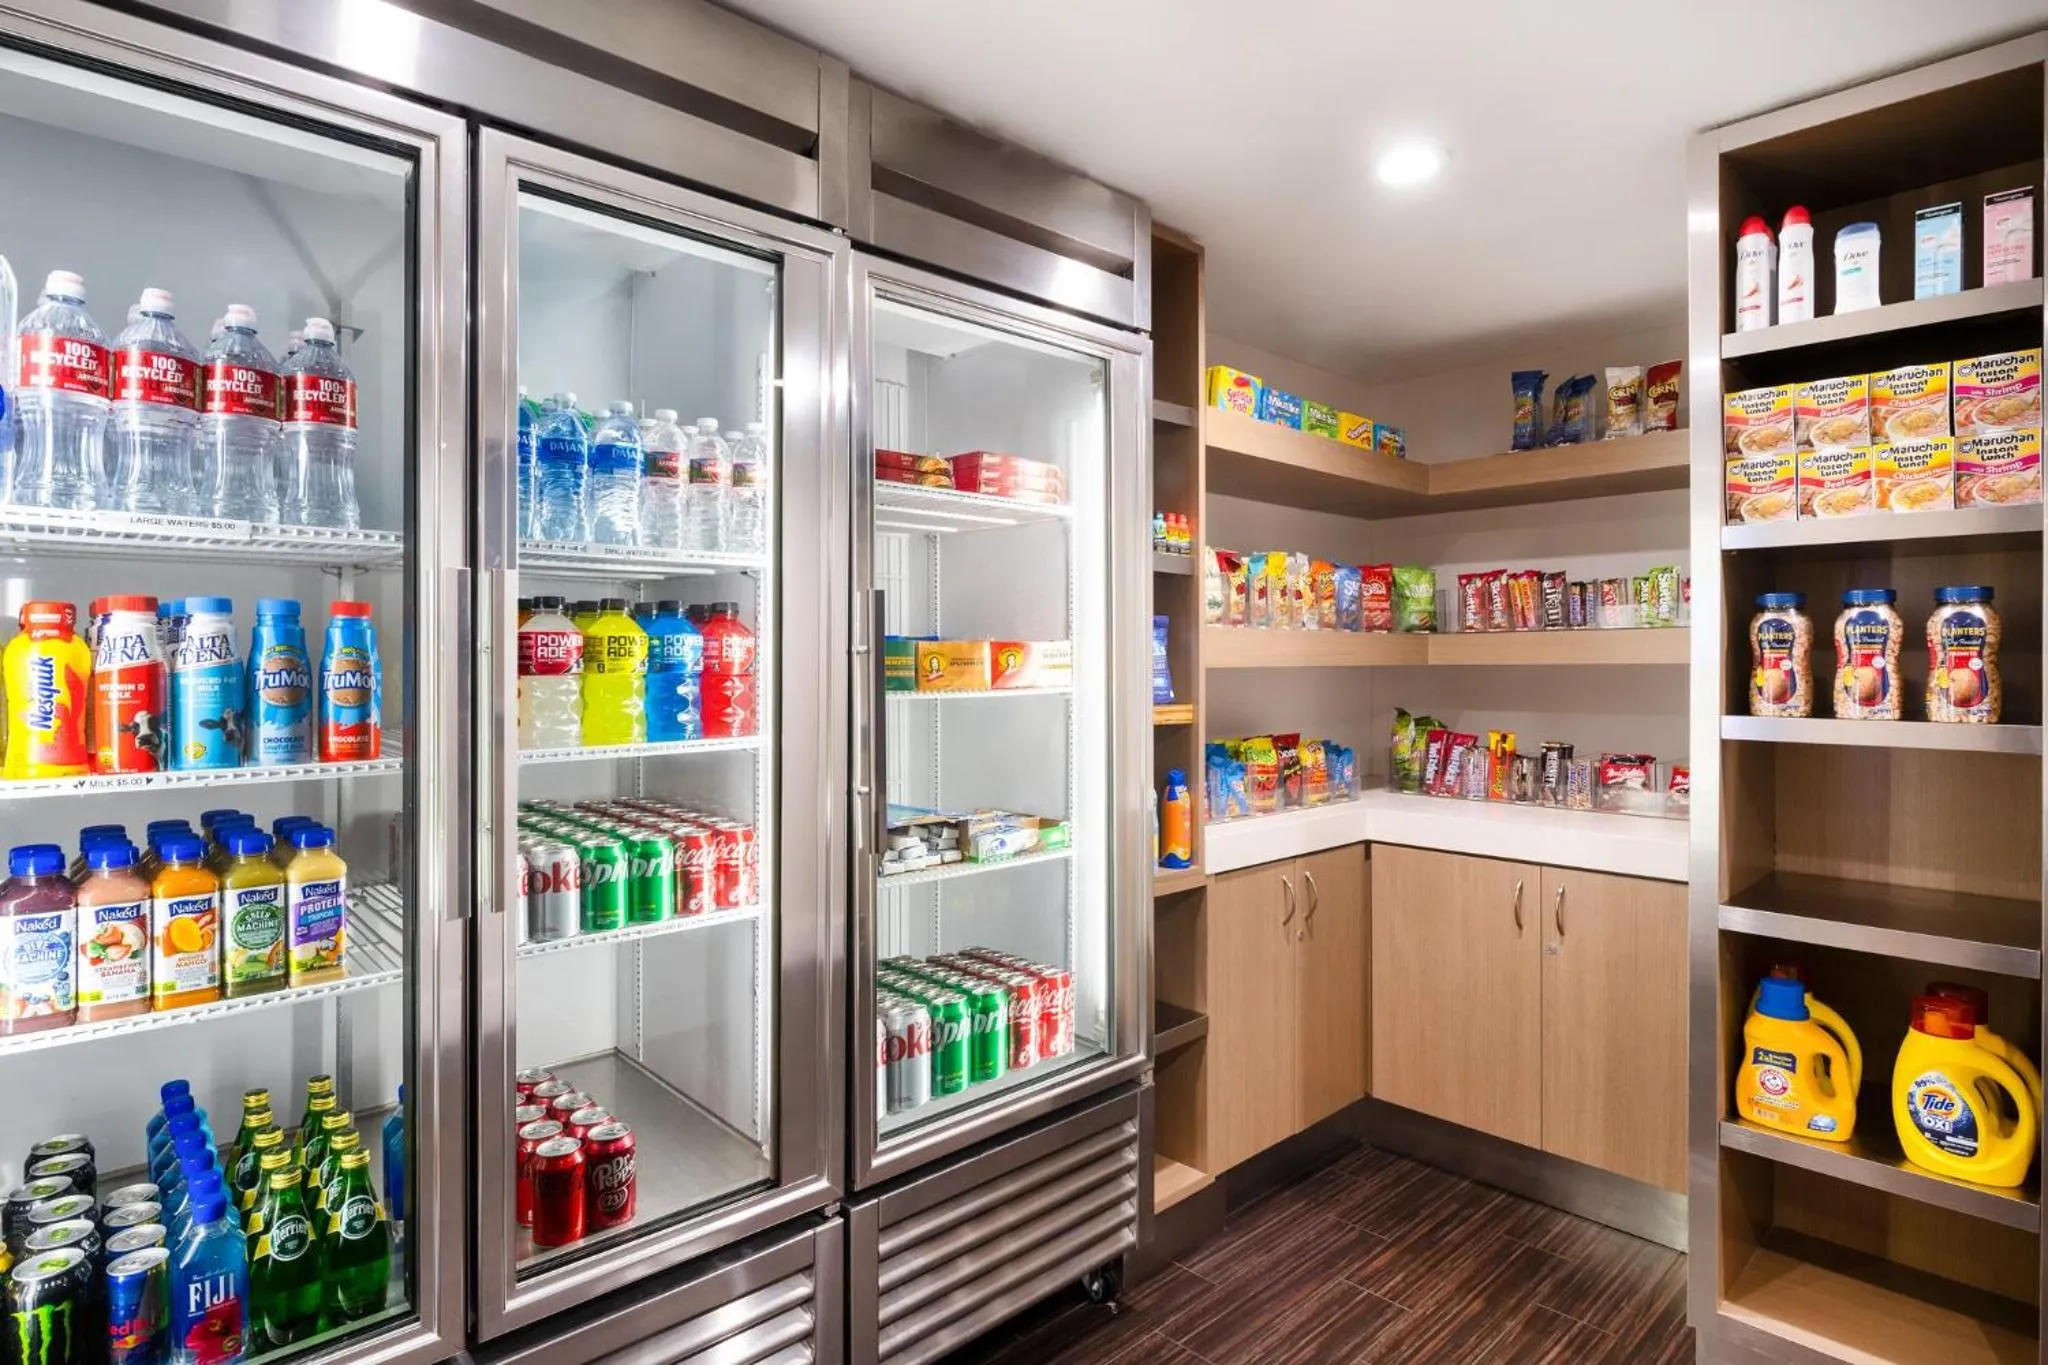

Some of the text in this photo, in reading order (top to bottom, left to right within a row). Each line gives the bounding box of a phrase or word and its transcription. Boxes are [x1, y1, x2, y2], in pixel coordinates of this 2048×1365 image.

[64, 341, 97, 359] 100%
[31, 351, 98, 371] CYCLED
[151, 355, 183, 373] 100%
[1971, 354, 2034, 370] Maruchan
[121, 366, 184, 383] RECYCLED
[232, 368, 262, 384] 100%
[1886, 368, 1943, 381] Maruchan
[1976, 366, 2019, 377] Instant
[1889, 379, 1928, 389] Instant
[1980, 375, 2015, 384] Lunch
[202, 379, 263, 395] RECYCLED
[319, 379, 346, 393] 100%
[1808, 379, 1862, 393] Maruchan
[1893, 387, 1925, 396] Lunch
[1985, 382, 2023, 396] Shrimp
[293, 389, 348, 404] RECYCLED
[1738, 389, 1788, 402] Maruchan
[1812, 390, 1849, 400] Instant
[1742, 400, 1776, 409] Instant
[1816, 397, 1846, 406] Lunch
[1888, 397, 1924, 408] Chicken
[1745, 407, 1772, 415] Lunch
[1972, 433, 2034, 448] Maruchan
[612, 447, 640, 459] DASA
[1890, 443, 1947, 456] Maruchan
[1976, 445, 2019, 455] Instant
[1813, 451, 1867, 463] Maruchan
[1893, 453, 1932, 463] Instant
[1981, 452, 2015, 461] Lunch
[1740, 459, 1791, 470] Maruchan
[1816, 462, 1853, 471] Instant
[1897, 461, 1929, 469] Lunch
[1986, 461, 2023, 474] Shrimp
[1744, 469, 1778, 477] Instant
[1747, 475, 1775, 483] Lunch
[1820, 469, 1849, 477] Lunch
[1893, 470, 1933, 480] Chicken
[131, 517, 164, 526] LARGE
[167, 519, 208, 528] WATERS
[1845, 625, 1888, 634] PLANTERS
[1942, 627, 1985, 636] PLANTERS
[537, 646, 567, 658] ADE
[607, 646, 635, 657] ADE
[30, 656, 61, 729] Nesquik
[90, 779, 113, 789] MILK
[581, 857, 628, 890] Spri
[932, 1014, 971, 1049] Spri
[1923, 1094, 1955, 1111] Tide
[1923, 1117, 1950, 1131] OXI
[612, 1154, 630, 1172] Dr
[593, 1160, 635, 1190] Peppe
[188, 1273, 235, 1313] FIJI
